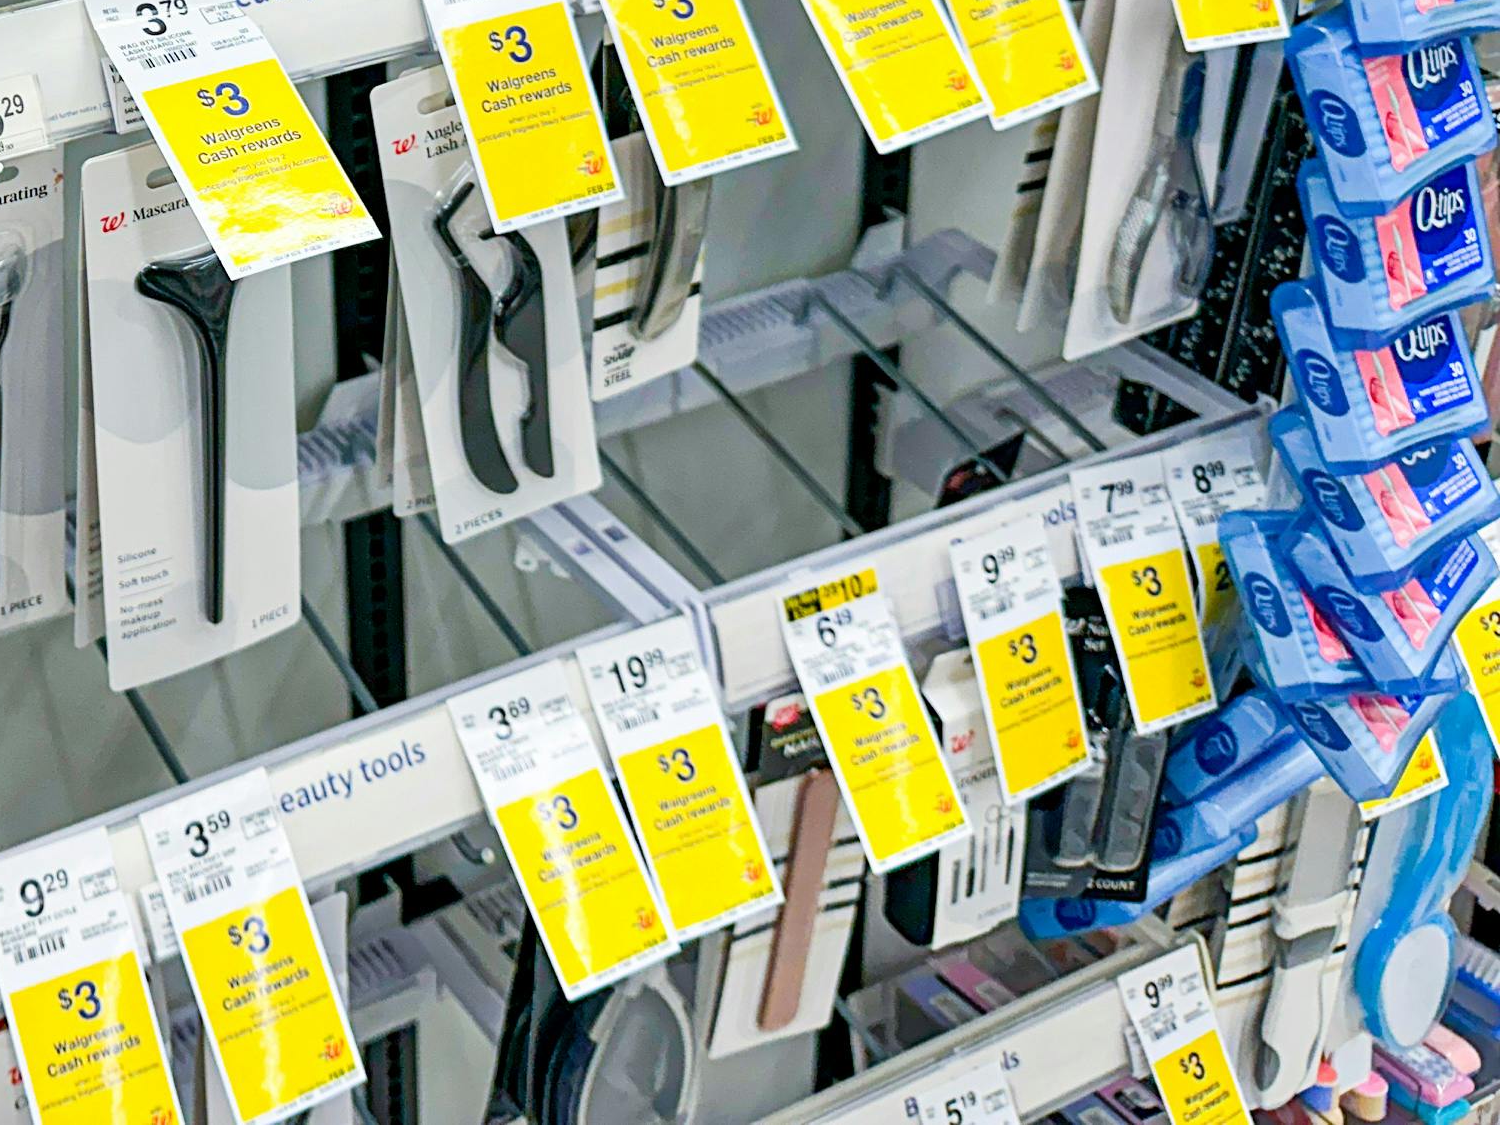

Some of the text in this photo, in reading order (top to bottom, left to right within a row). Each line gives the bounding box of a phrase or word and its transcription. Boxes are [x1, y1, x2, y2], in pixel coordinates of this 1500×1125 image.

[485, 66, 557, 93] Walgreens
[197, 81, 251, 117] $3
[480, 81, 573, 114] Cash rewards
[197, 128, 303, 166] Cash rewards
[201, 116, 281, 147] Walgreens
[425, 138, 459, 160] Lash
[357, 740, 427, 784] tools
